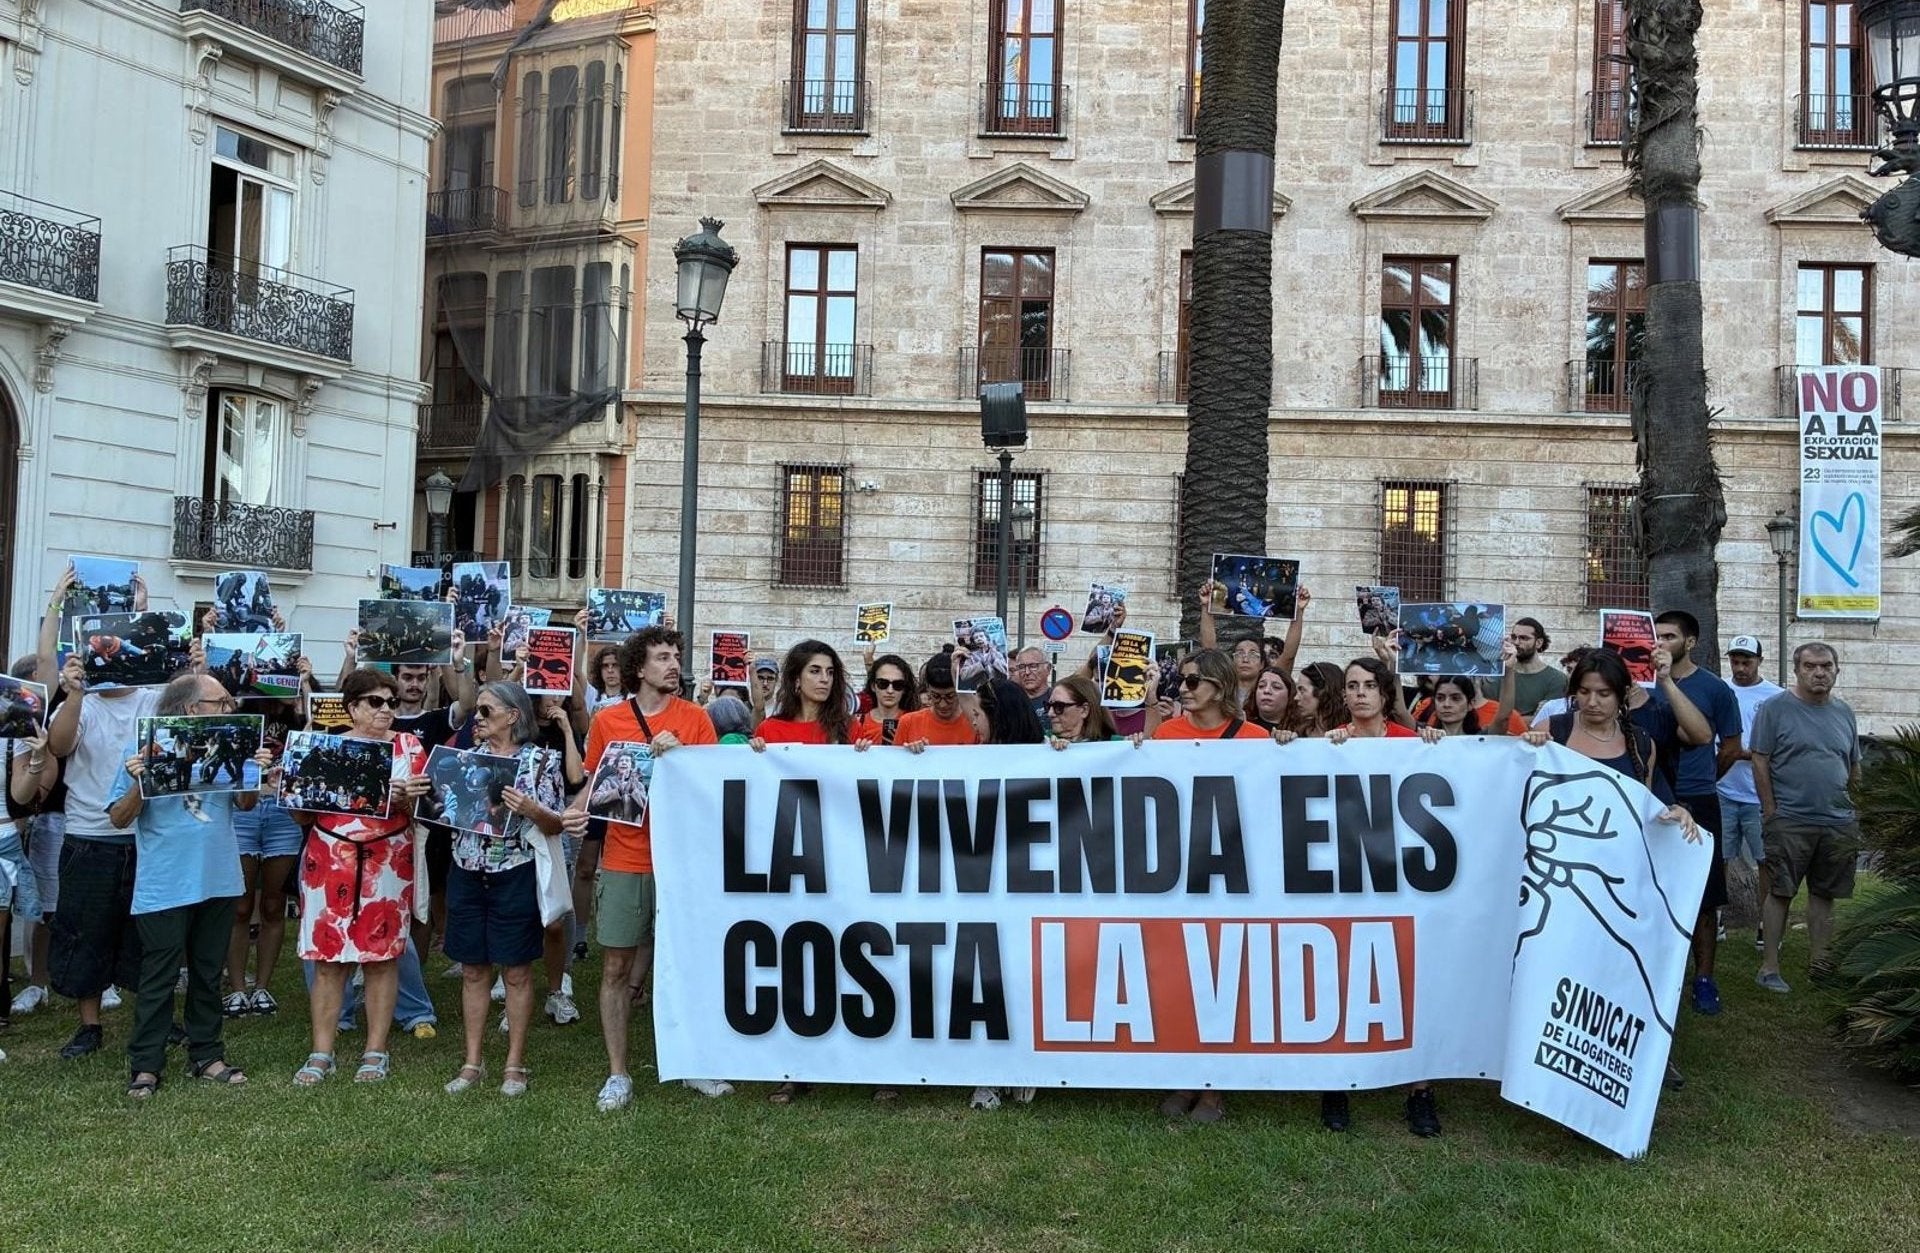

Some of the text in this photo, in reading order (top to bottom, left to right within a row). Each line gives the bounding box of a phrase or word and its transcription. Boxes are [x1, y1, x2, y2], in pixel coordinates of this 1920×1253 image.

[1801, 371, 1878, 413] NO
[1804, 415, 1879, 436] A LA
[1804, 435, 1879, 446] EXPLOTACIÓN
[1803, 467, 1821, 480] 23
[1804, 446, 1879, 461] SEXUAL
[722, 772, 1459, 895] LA VIVENDA ENS
[723, 920, 1405, 1044] COSTA LA VIDA
[1551, 977, 1646, 1060] SINDICAT
[1542, 1022, 1633, 1083] DE LLOGATERES
